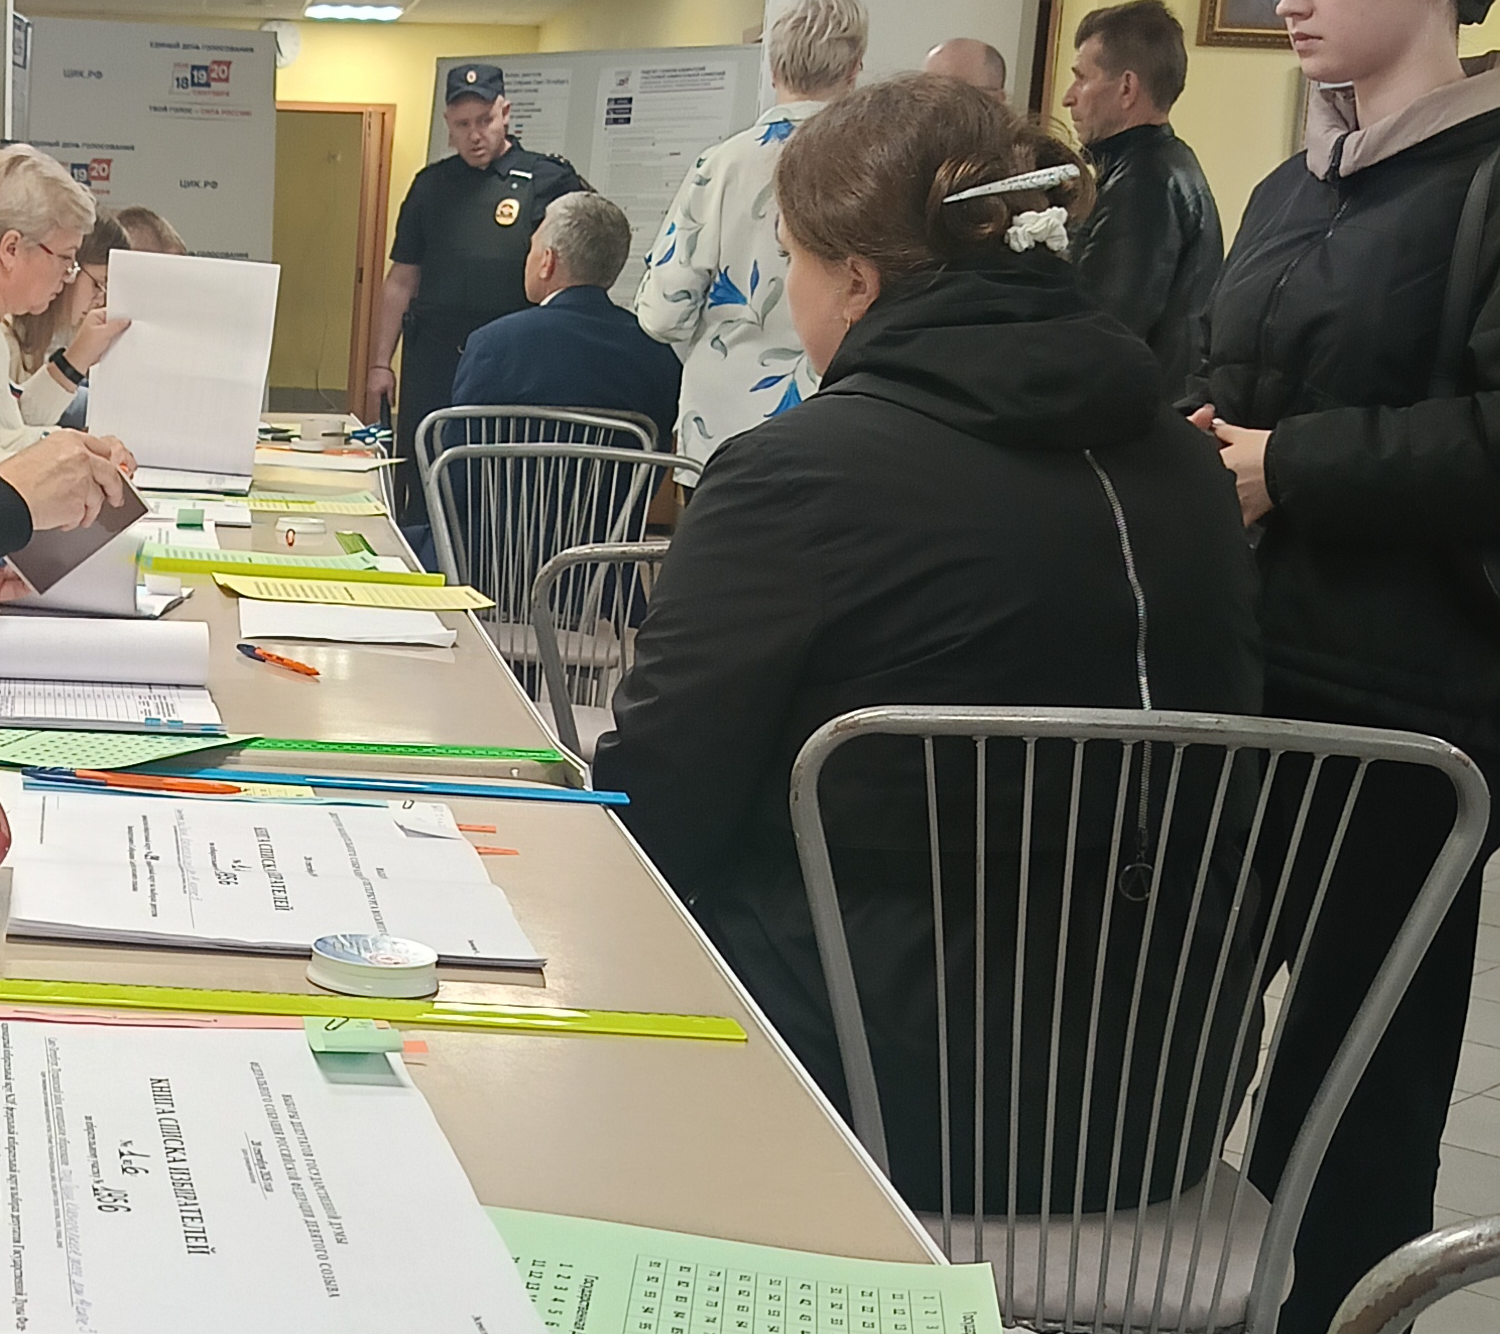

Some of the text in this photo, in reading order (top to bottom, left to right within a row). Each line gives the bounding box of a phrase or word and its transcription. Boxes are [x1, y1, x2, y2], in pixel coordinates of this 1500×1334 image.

[63, 69, 104, 80] ЦИК.РФ
[175, 65, 228, 90] 18 19 20
[73, 164, 109, 182] 19 20
[179, 179, 219, 190] ЦИК.РФ
[264, 1103, 285, 1135] СОБРАНИЯ
[149, 1078, 217, 1255] КНИГА СПИСКА ИЗБИРАТЕЛЕЙ
[275, 1136, 302, 1181] РОССИЙСКОЙ
[92, 1184, 132, 1213] 1956
[289, 1121, 314, 1157] ДЕПУТАТОВ
[304, 1158, 342, 1219] ГОСУДАРСТВЕННОЙ
[327, 1220, 349, 1245] ДУМЫ
[290, 1182, 316, 1218] ФЕДЕРАЦИИ
[302, 1219, 329, 1261] ДЕВЯТОГО
[319, 1262, 341, 1298] СОЗЫВА
